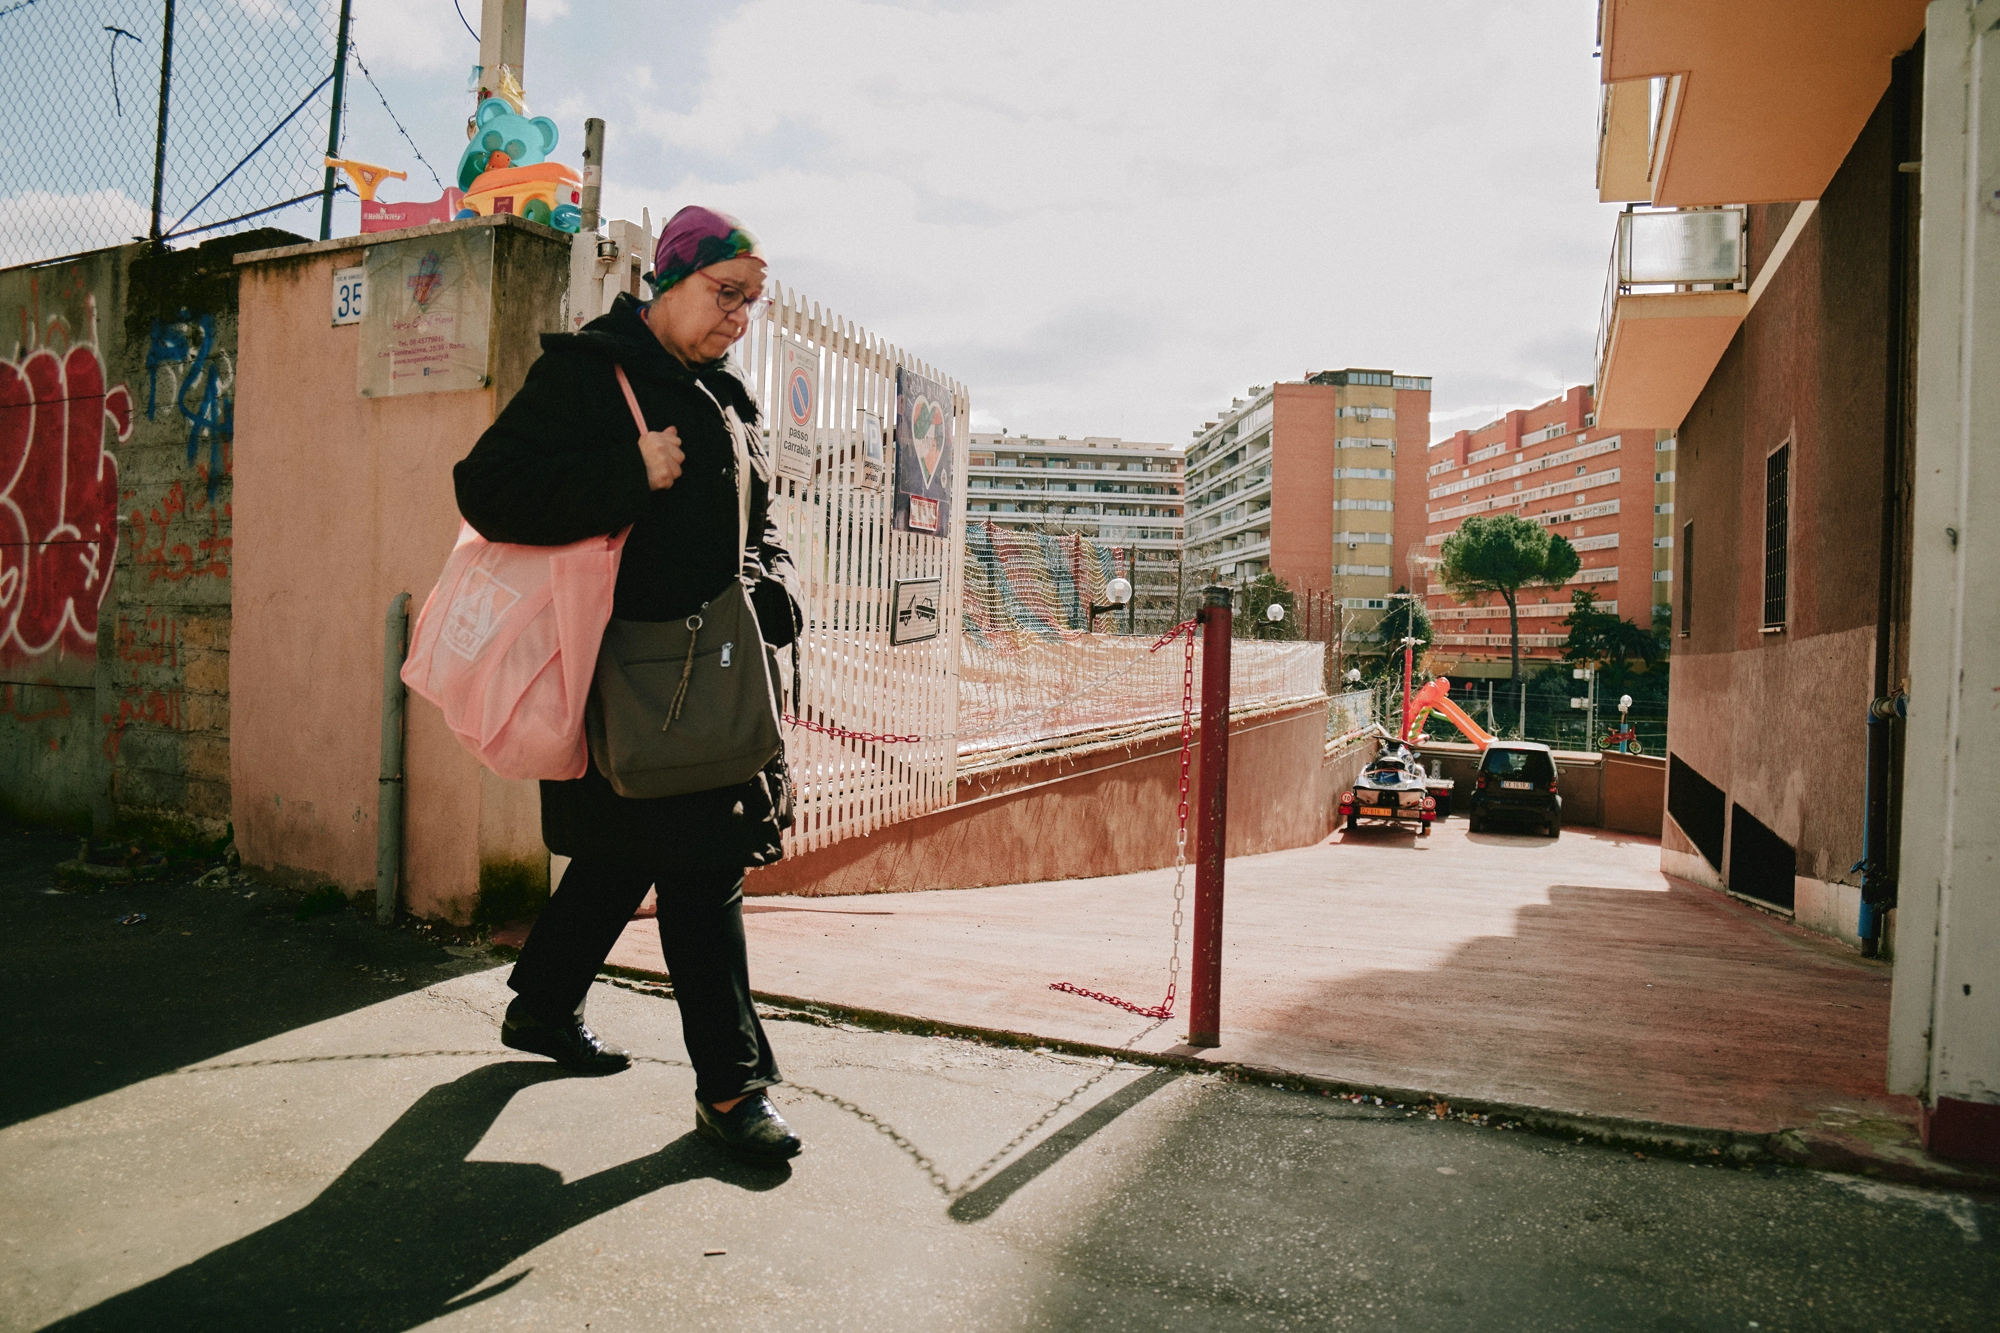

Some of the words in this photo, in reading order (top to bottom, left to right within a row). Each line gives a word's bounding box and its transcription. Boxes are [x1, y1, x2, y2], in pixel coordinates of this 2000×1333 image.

[384, 213, 400, 221] Kitty
[338, 283, 362, 317] 35
[789, 427, 808, 442] passo
[869, 423, 879, 454] P
[783, 440, 811, 458] carrabile
[865, 472, 878, 483] privato
